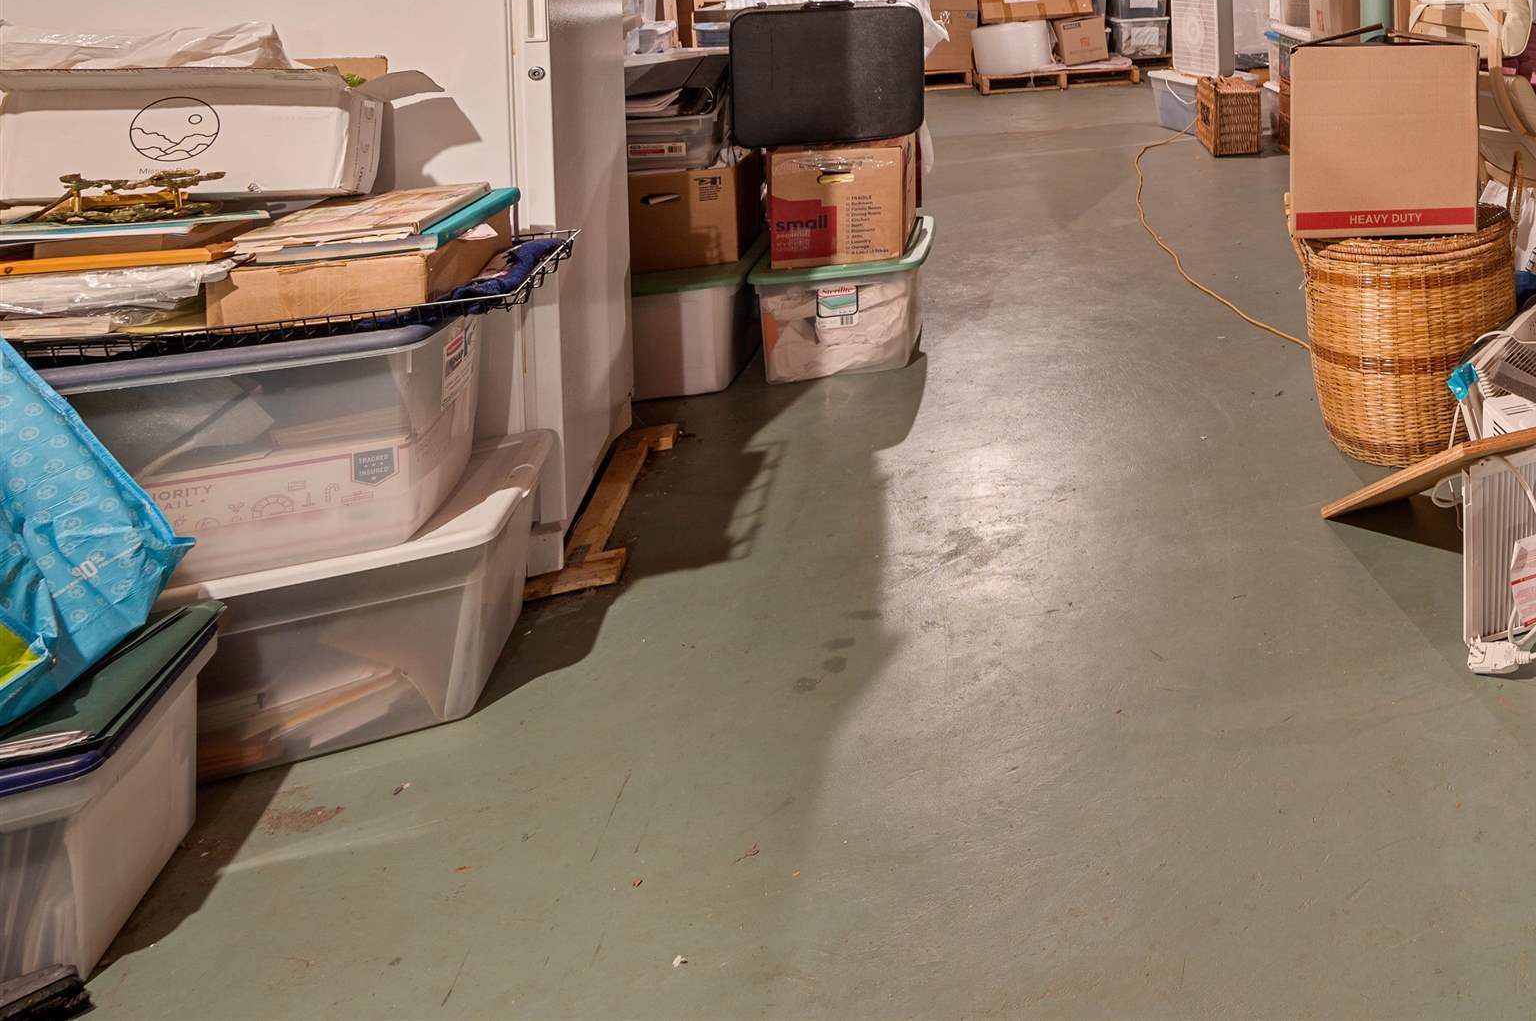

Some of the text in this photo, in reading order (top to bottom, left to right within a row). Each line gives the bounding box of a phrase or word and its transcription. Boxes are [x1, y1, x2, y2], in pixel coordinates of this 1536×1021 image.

[775, 214, 829, 232] small
[1350, 213, 1422, 225] HEAVY DUTY
[153, 484, 213, 500] IORITY
[164, 499, 193, 511] AIL
